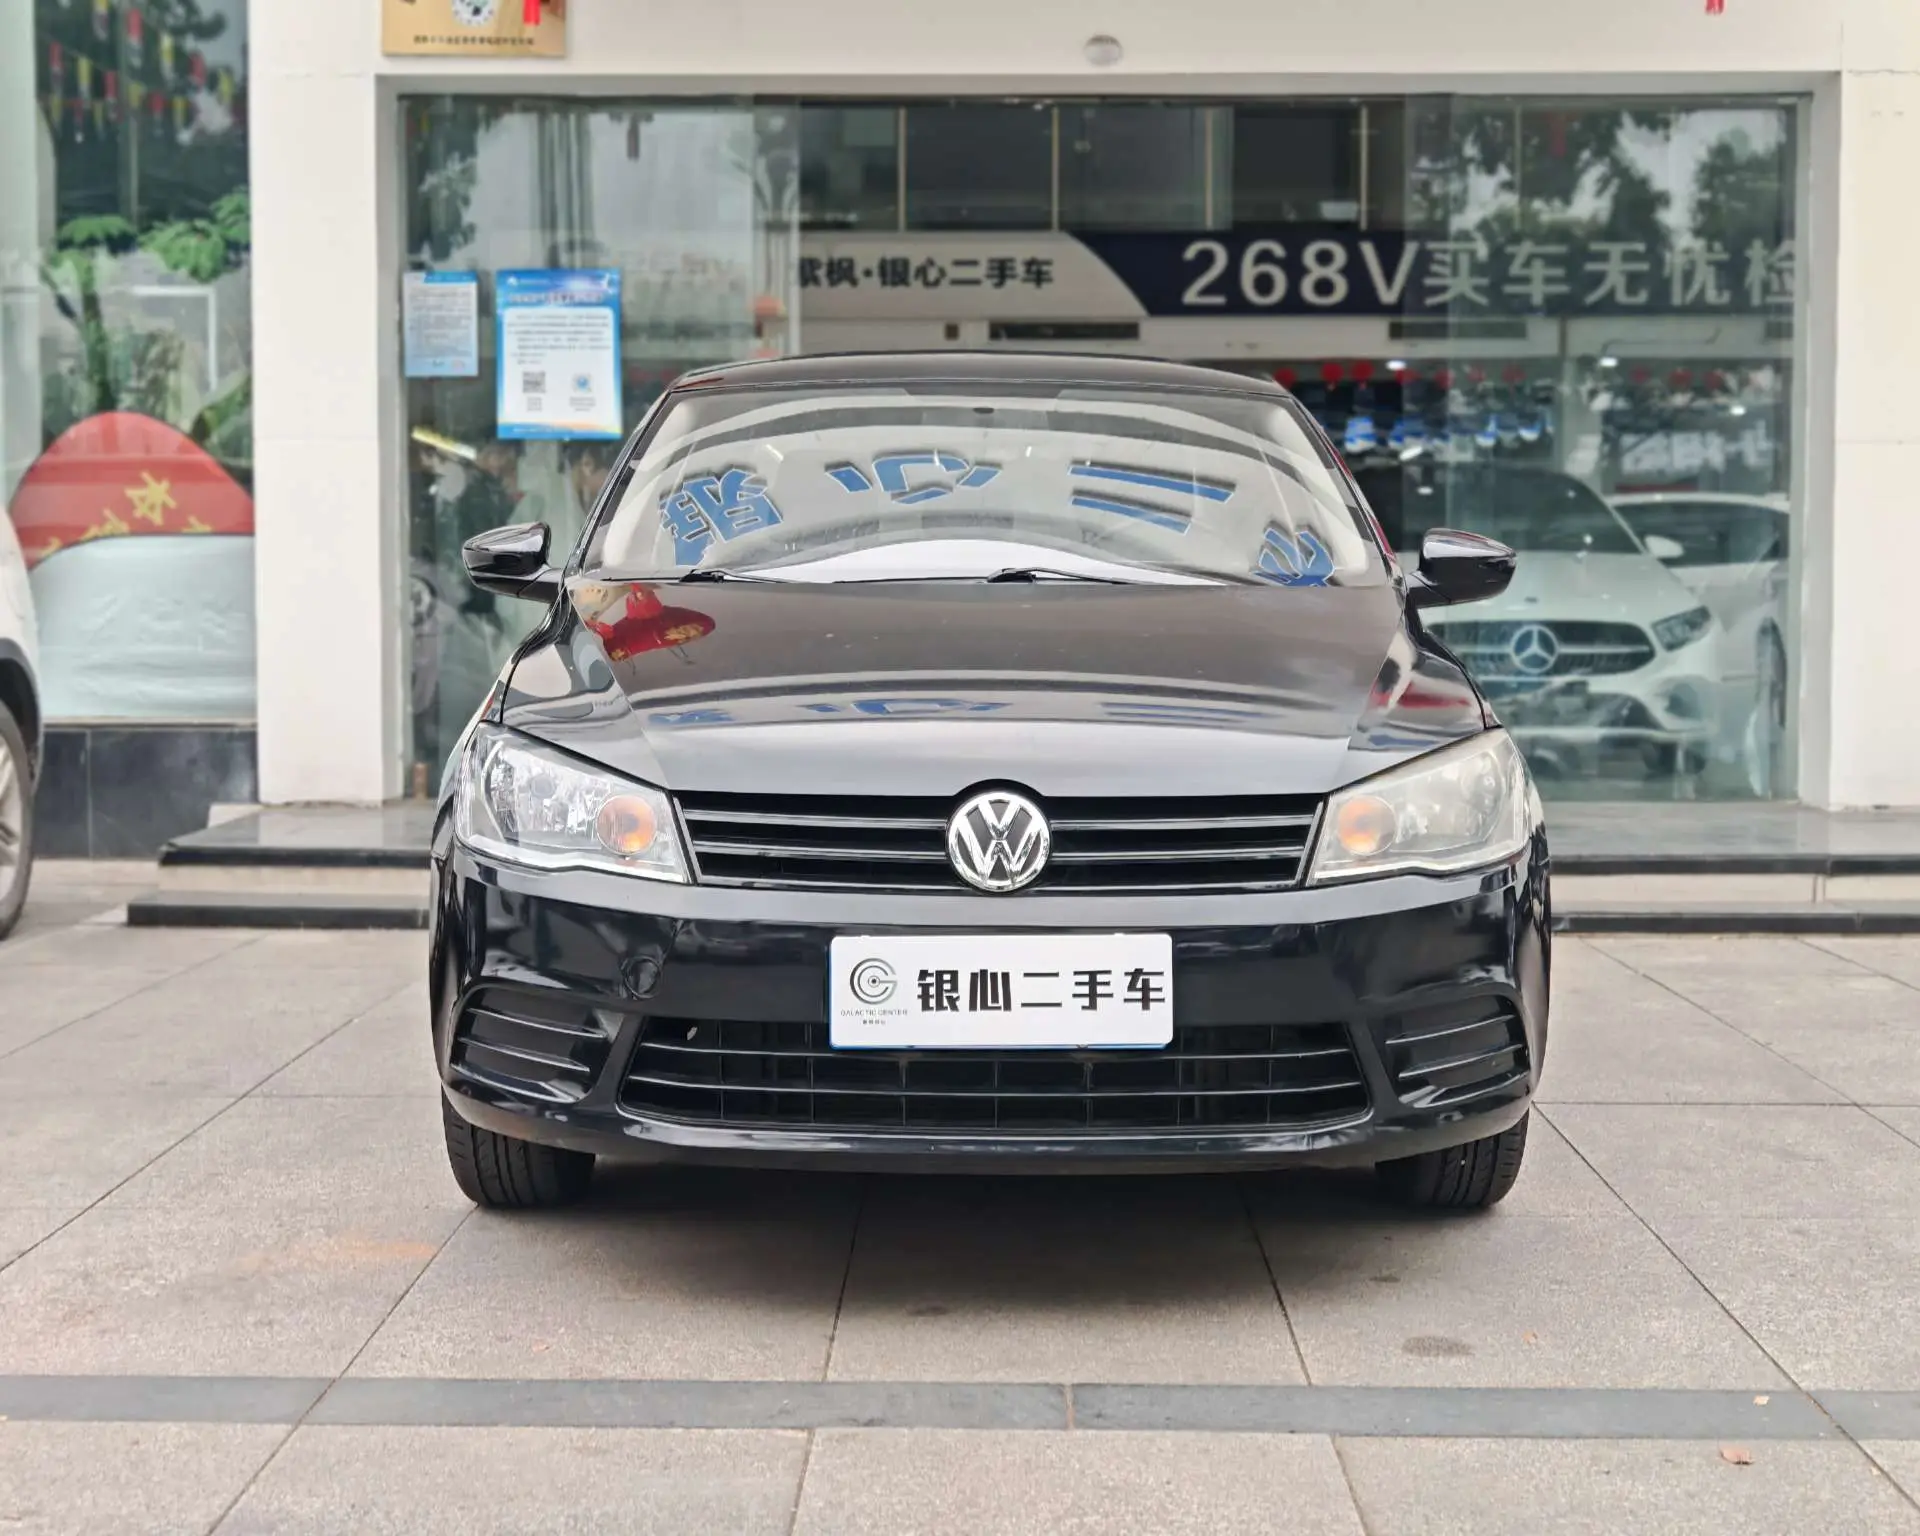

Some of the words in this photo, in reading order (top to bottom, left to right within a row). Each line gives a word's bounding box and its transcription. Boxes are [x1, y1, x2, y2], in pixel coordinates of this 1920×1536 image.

[916, 967, 1166, 1013] 银心二手车
